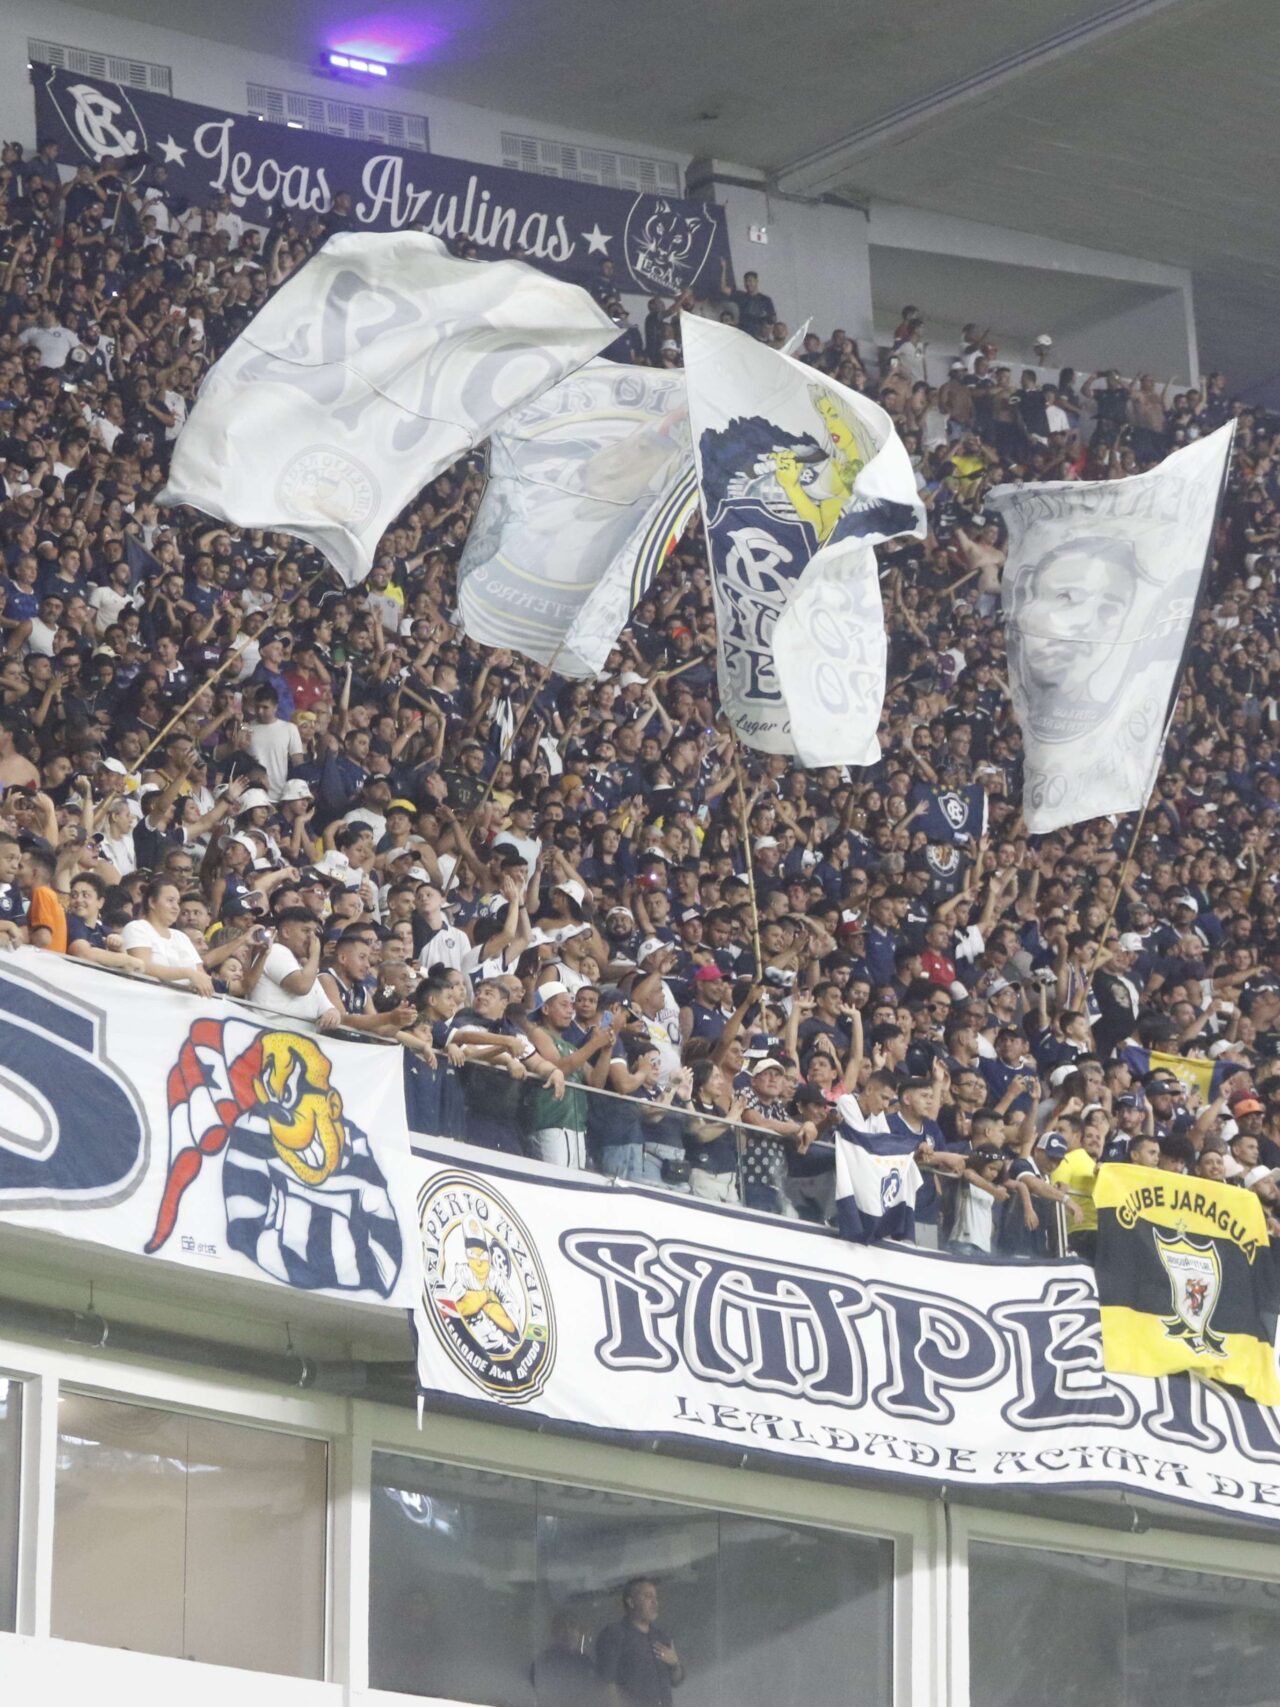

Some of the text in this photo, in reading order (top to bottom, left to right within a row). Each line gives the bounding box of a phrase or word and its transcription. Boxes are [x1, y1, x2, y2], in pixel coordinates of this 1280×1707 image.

[194, 118, 576, 262] Leoas Azulinas
[736, 713, 777, 736] Lugar
[1117, 1186, 1259, 1265] CLUBE JARAGUÁ
[672, 1396, 977, 1474] LEALDADE
[993, 1445, 1193, 1489] ACIMA
